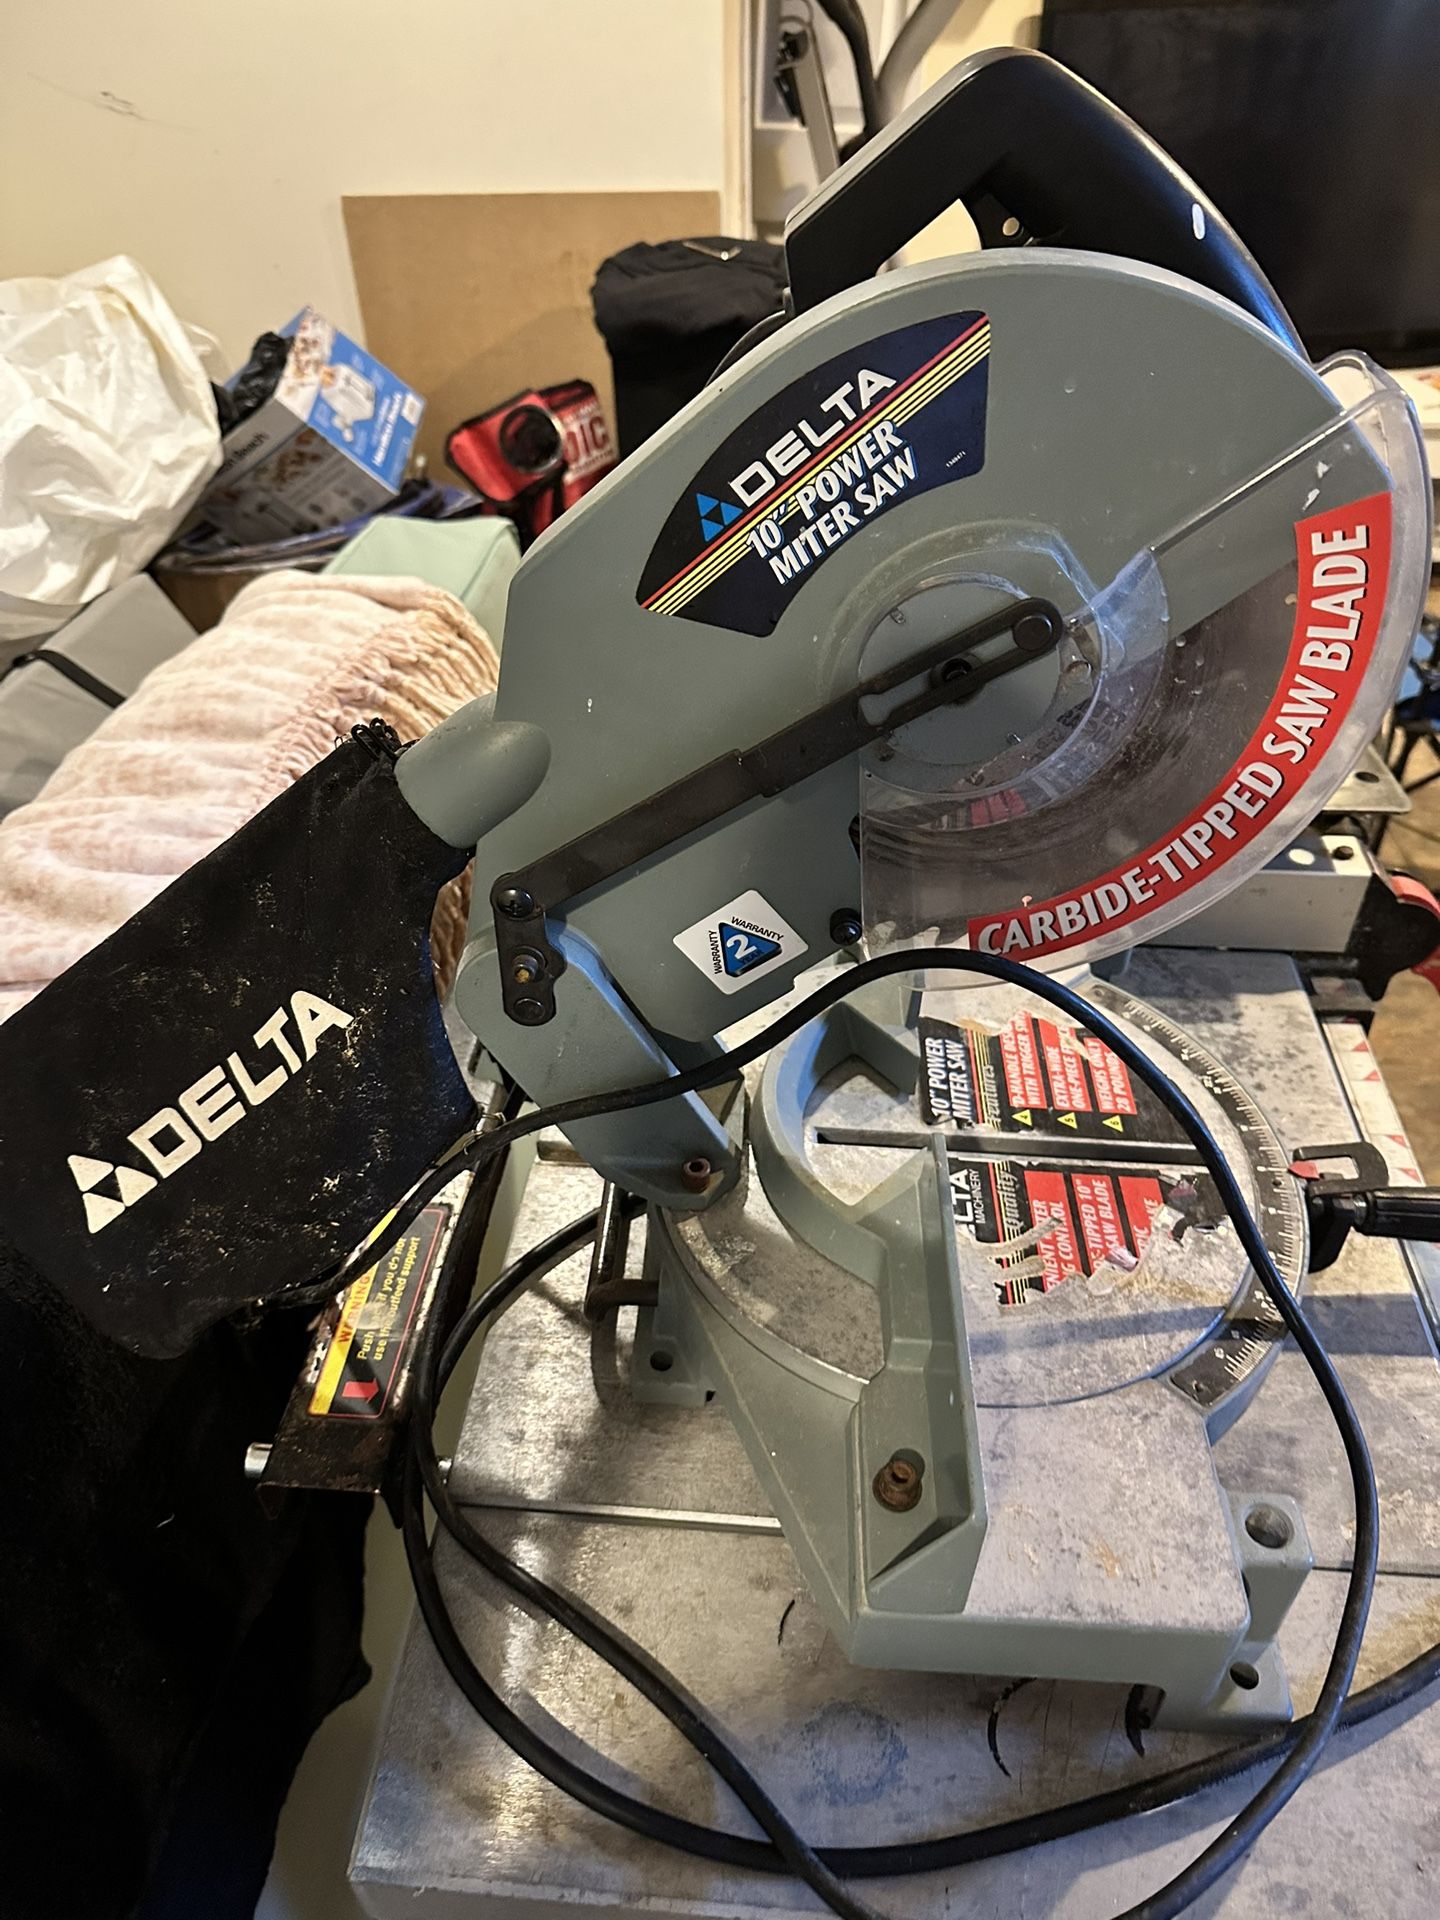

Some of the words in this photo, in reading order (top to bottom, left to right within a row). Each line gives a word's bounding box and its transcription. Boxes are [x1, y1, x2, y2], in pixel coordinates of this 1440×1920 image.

[730, 369, 896, 507] DELTA
[797, 420, 904, 521] POWER
[769, 501, 860, 585] MITER
[854, 447, 917, 516] SAW
[977, 761, 1283, 957] CARBIDE-TIPPED
[1263, 678, 1336, 765] SAW
[1300, 524, 1370, 672] BLADE
[708, 930, 723, 975] WARRANTY
[726, 933, 757, 960] 2
[731, 916, 784, 941] WARRANTY
[925, 1037, 948, 1089] POWER
[945, 1039, 967, 1071] SAW
[1017, 1033, 1036, 1076] TRIGGER
[1045, 1046, 1070, 1108] EXTRA-WIDE
[1087, 1041, 1105, 1068] ONLY
[127, 990, 354, 1179] DELTA
[949, 1072, 972, 1120] MITER
[984, 1065, 1001, 1122] Features
[1024, 1077, 1040, 1105] WITH
[1062, 1055, 1086, 1109] ONE-PIECE
[1093, 1069, 1116, 1110] WEIGHS
[1114, 1096, 1131, 1112] 28
[949, 1169, 976, 1233] LTA
[969, 1169, 985, 1224] MACHINERY
[997, 1170, 1023, 1231] Quality
[1092, 1179, 1114, 1220] BLADE
[1039, 1241, 1060, 1290] ENIENT
[357, 1331, 376, 1360] Push
[382, 1272, 395, 1292] you
[373, 1339, 387, 1361] use
[390, 1277, 407, 1318] outfeed
[401, 1236, 421, 1277] support
